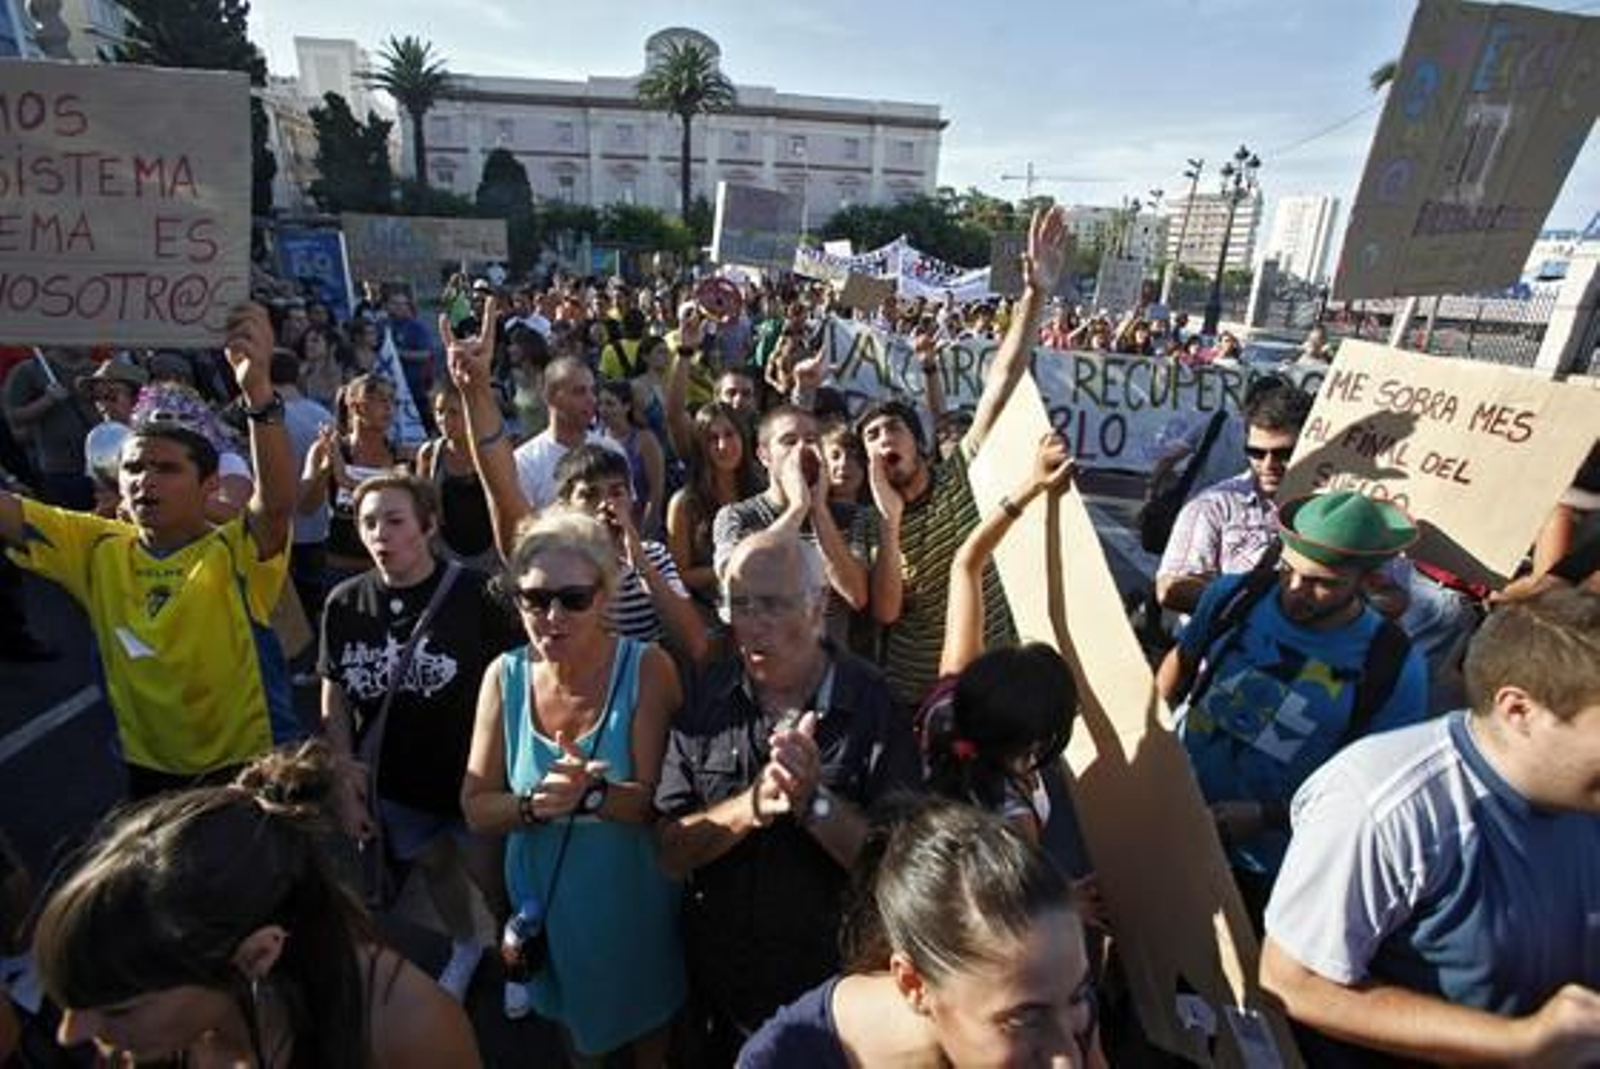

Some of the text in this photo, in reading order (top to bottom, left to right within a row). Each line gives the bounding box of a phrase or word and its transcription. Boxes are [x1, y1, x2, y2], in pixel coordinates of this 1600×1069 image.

[155, 216, 218, 263] ES
[1326, 370, 1536, 443] ME SOBRA MES
[1420, 452, 1472, 484] DEL
